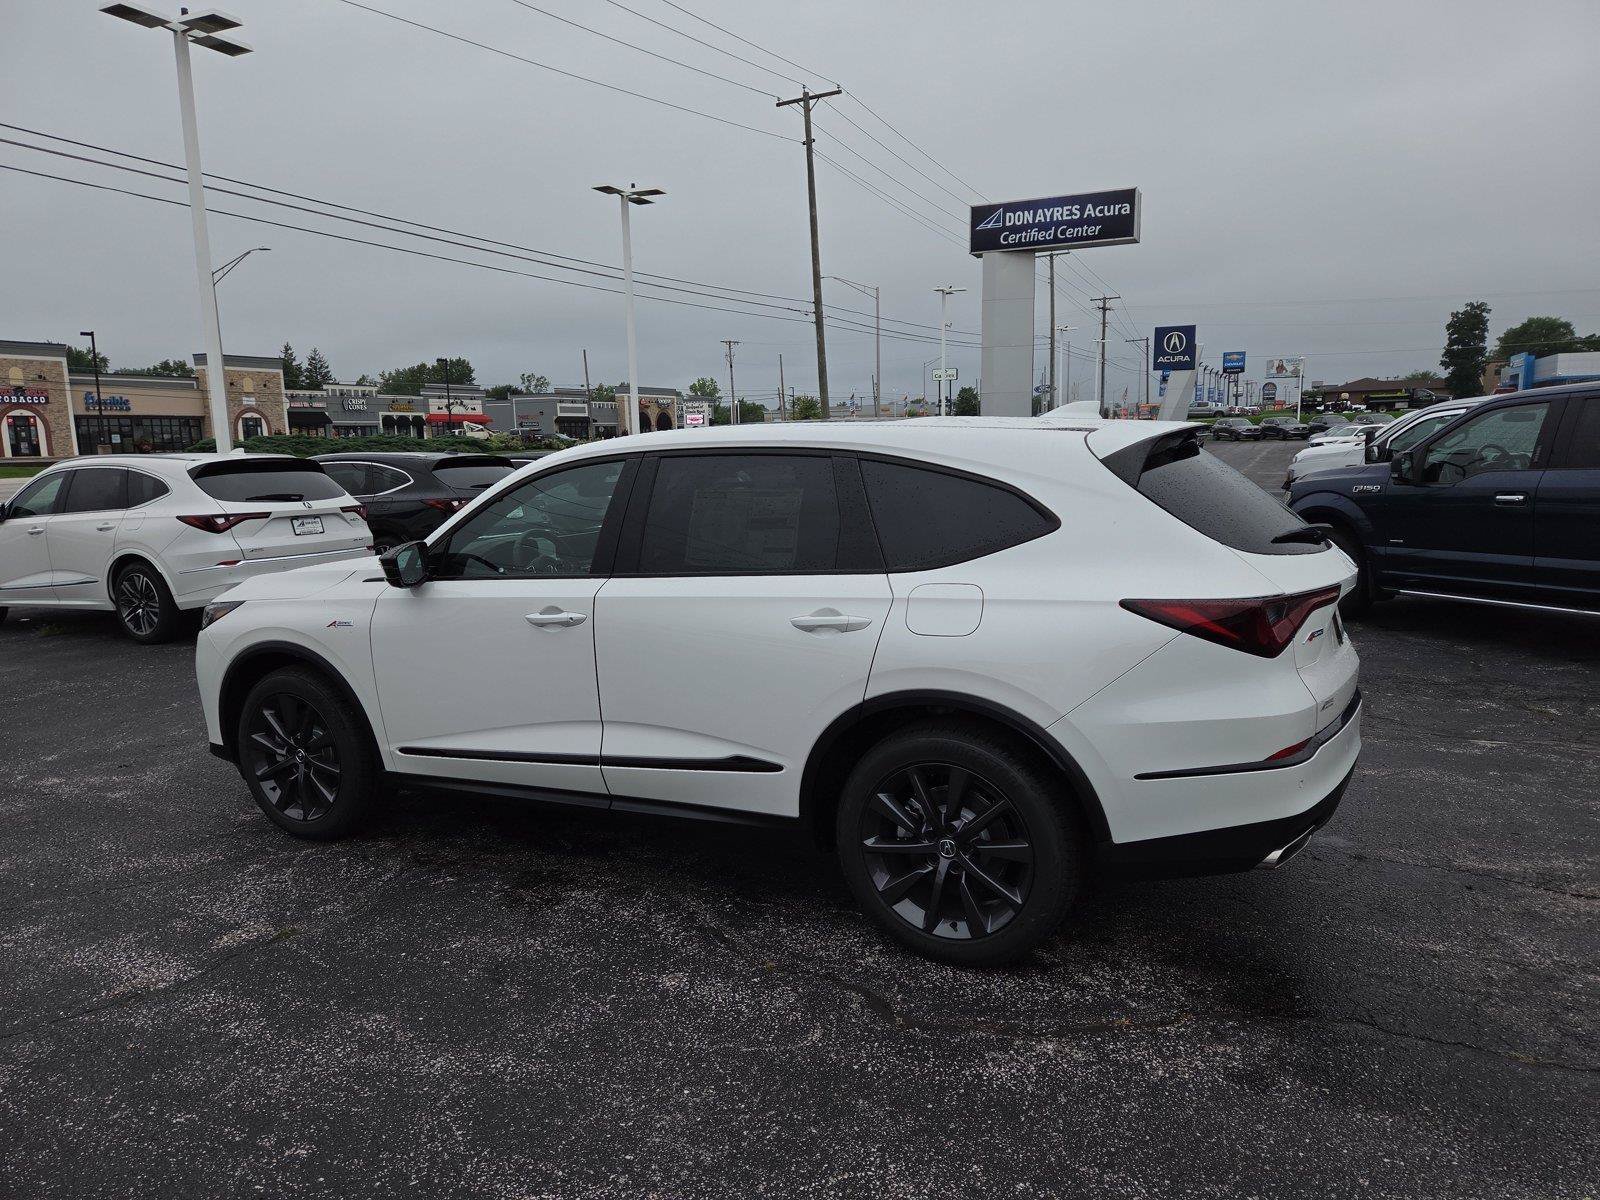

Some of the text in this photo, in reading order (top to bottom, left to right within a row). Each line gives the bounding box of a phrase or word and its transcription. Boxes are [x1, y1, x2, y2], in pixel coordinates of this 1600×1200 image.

[1005, 202, 1131, 227] DON AYRES Acura
[1000, 224, 1102, 245] Certified Center
[1157, 355, 1191, 363] ACURA
